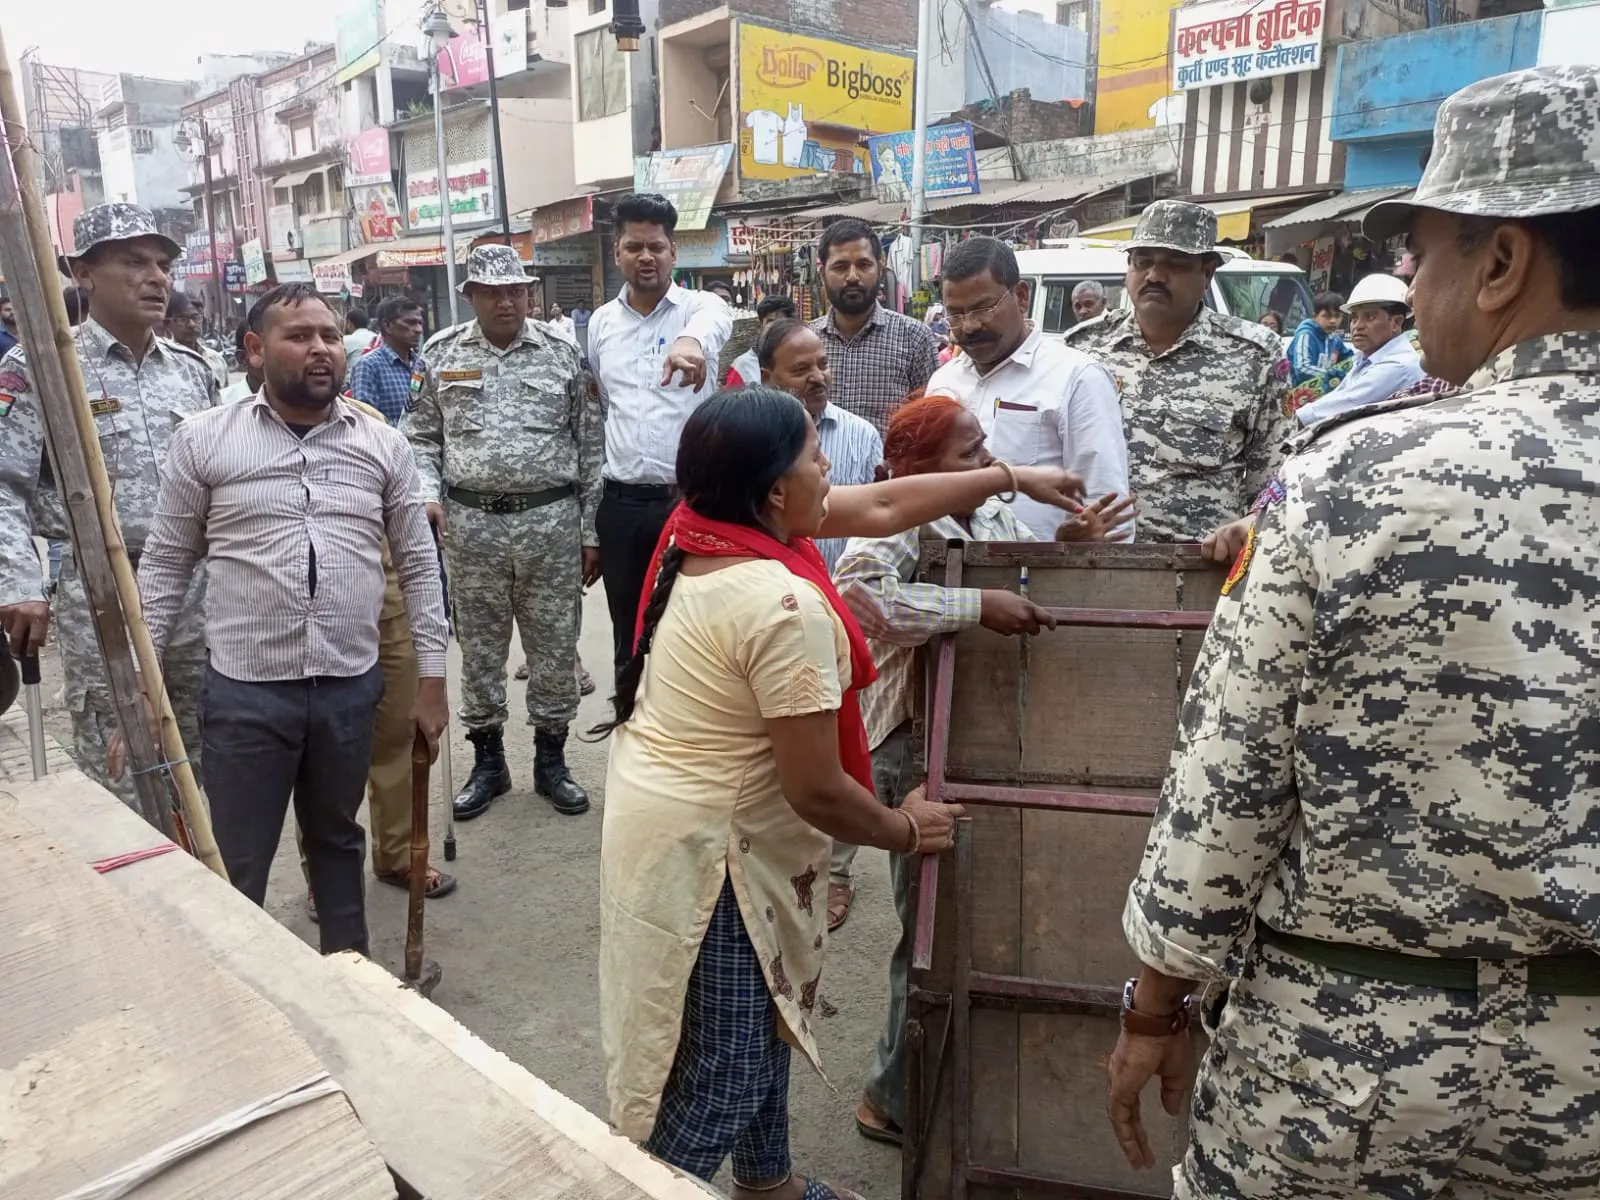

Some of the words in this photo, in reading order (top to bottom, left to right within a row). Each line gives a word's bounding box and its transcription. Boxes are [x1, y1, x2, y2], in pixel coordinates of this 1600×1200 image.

[1177, 13, 1252, 58] कल्पना
[1256, 0, 1322, 50] बुटिक
[762, 46, 817, 82] Dollar
[826, 58, 903, 100] Bigboss
[1177, 58, 1203, 88] कुर्ती
[1205, 57, 1230, 80] एण्ड
[1231, 54, 1254, 77] सूट
